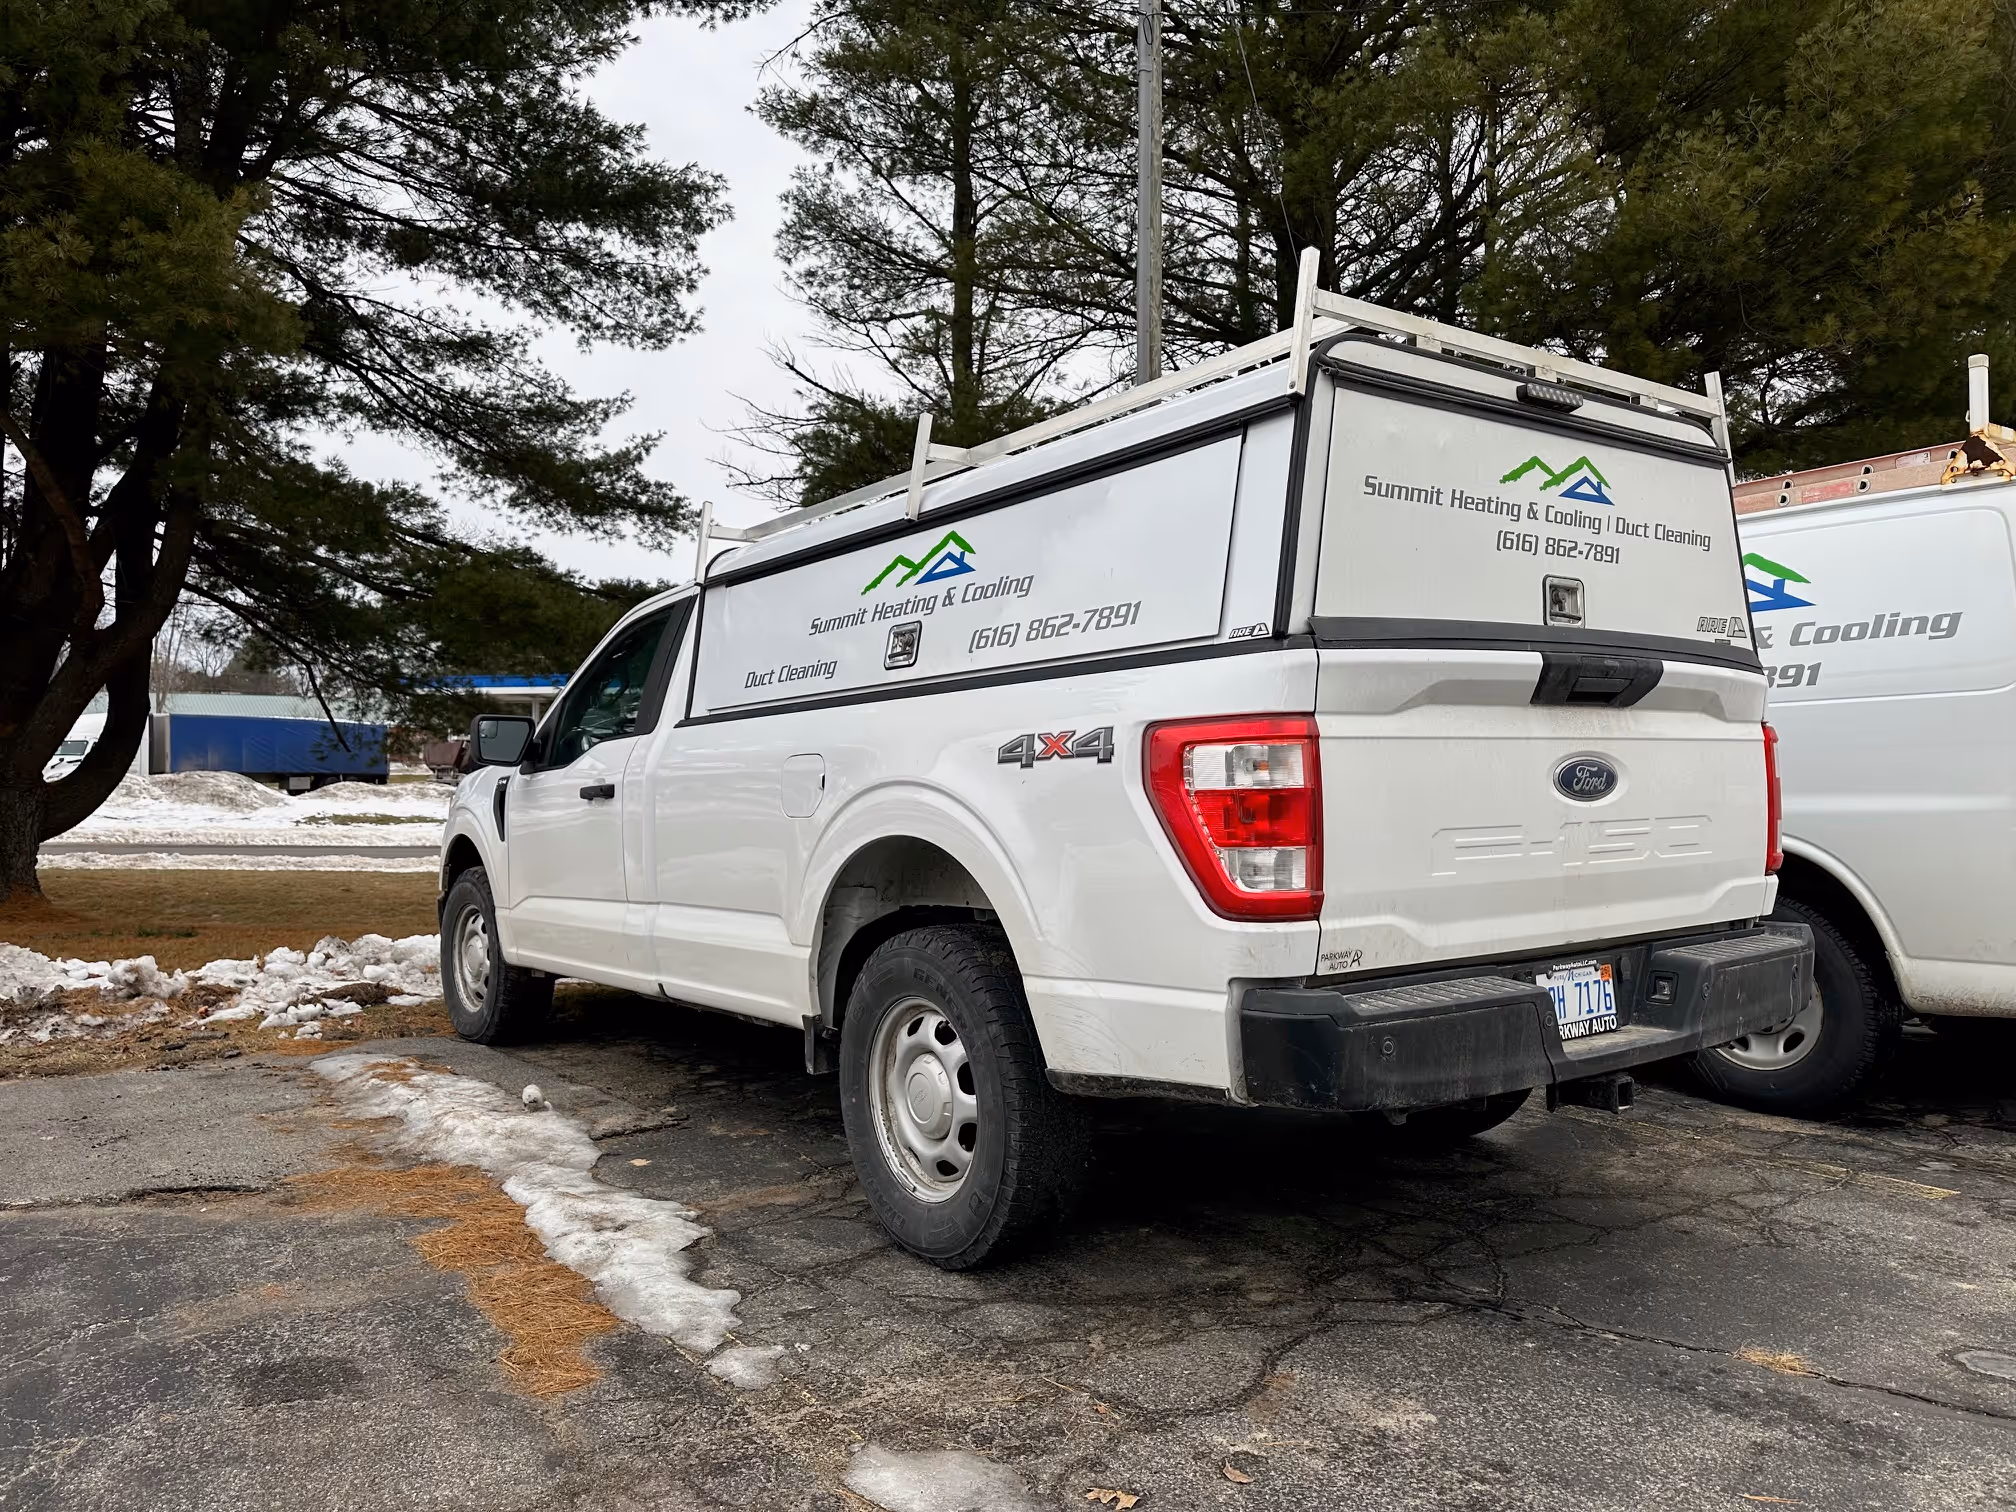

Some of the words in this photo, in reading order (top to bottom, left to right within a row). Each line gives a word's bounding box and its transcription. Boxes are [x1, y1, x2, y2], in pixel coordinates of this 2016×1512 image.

[1363, 474, 1444, 507] Summit
[1450, 488, 1522, 523] Heating
[1526, 501, 1540, 521] &
[1544, 504, 1603, 536] Cooling
[1615, 516, 1651, 539] Duct
[1654, 523, 1712, 552] Cleaning
[1496, 529, 1539, 556] (616)
[1544, 536, 1621, 565] 862-7891
[808, 607, 867, 636] Summit
[870, 590, 938, 623] Heating
[941, 586, 957, 608] &
[961, 573, 1035, 605] Cooling
[968, 622, 1018, 654] (616)
[1025, 601, 1141, 646] 862-7891
[1789, 611, 1964, 647] Cooling
[744, 669, 776, 689] Duct
[777, 659, 838, 684] Cleaning
[1573, 765, 1607, 791] Ford
[1329, 961, 1349, 971] AUTO
[1574, 978, 1613, 1016] 7176
[1592, 1014, 1618, 1034] AUTO
